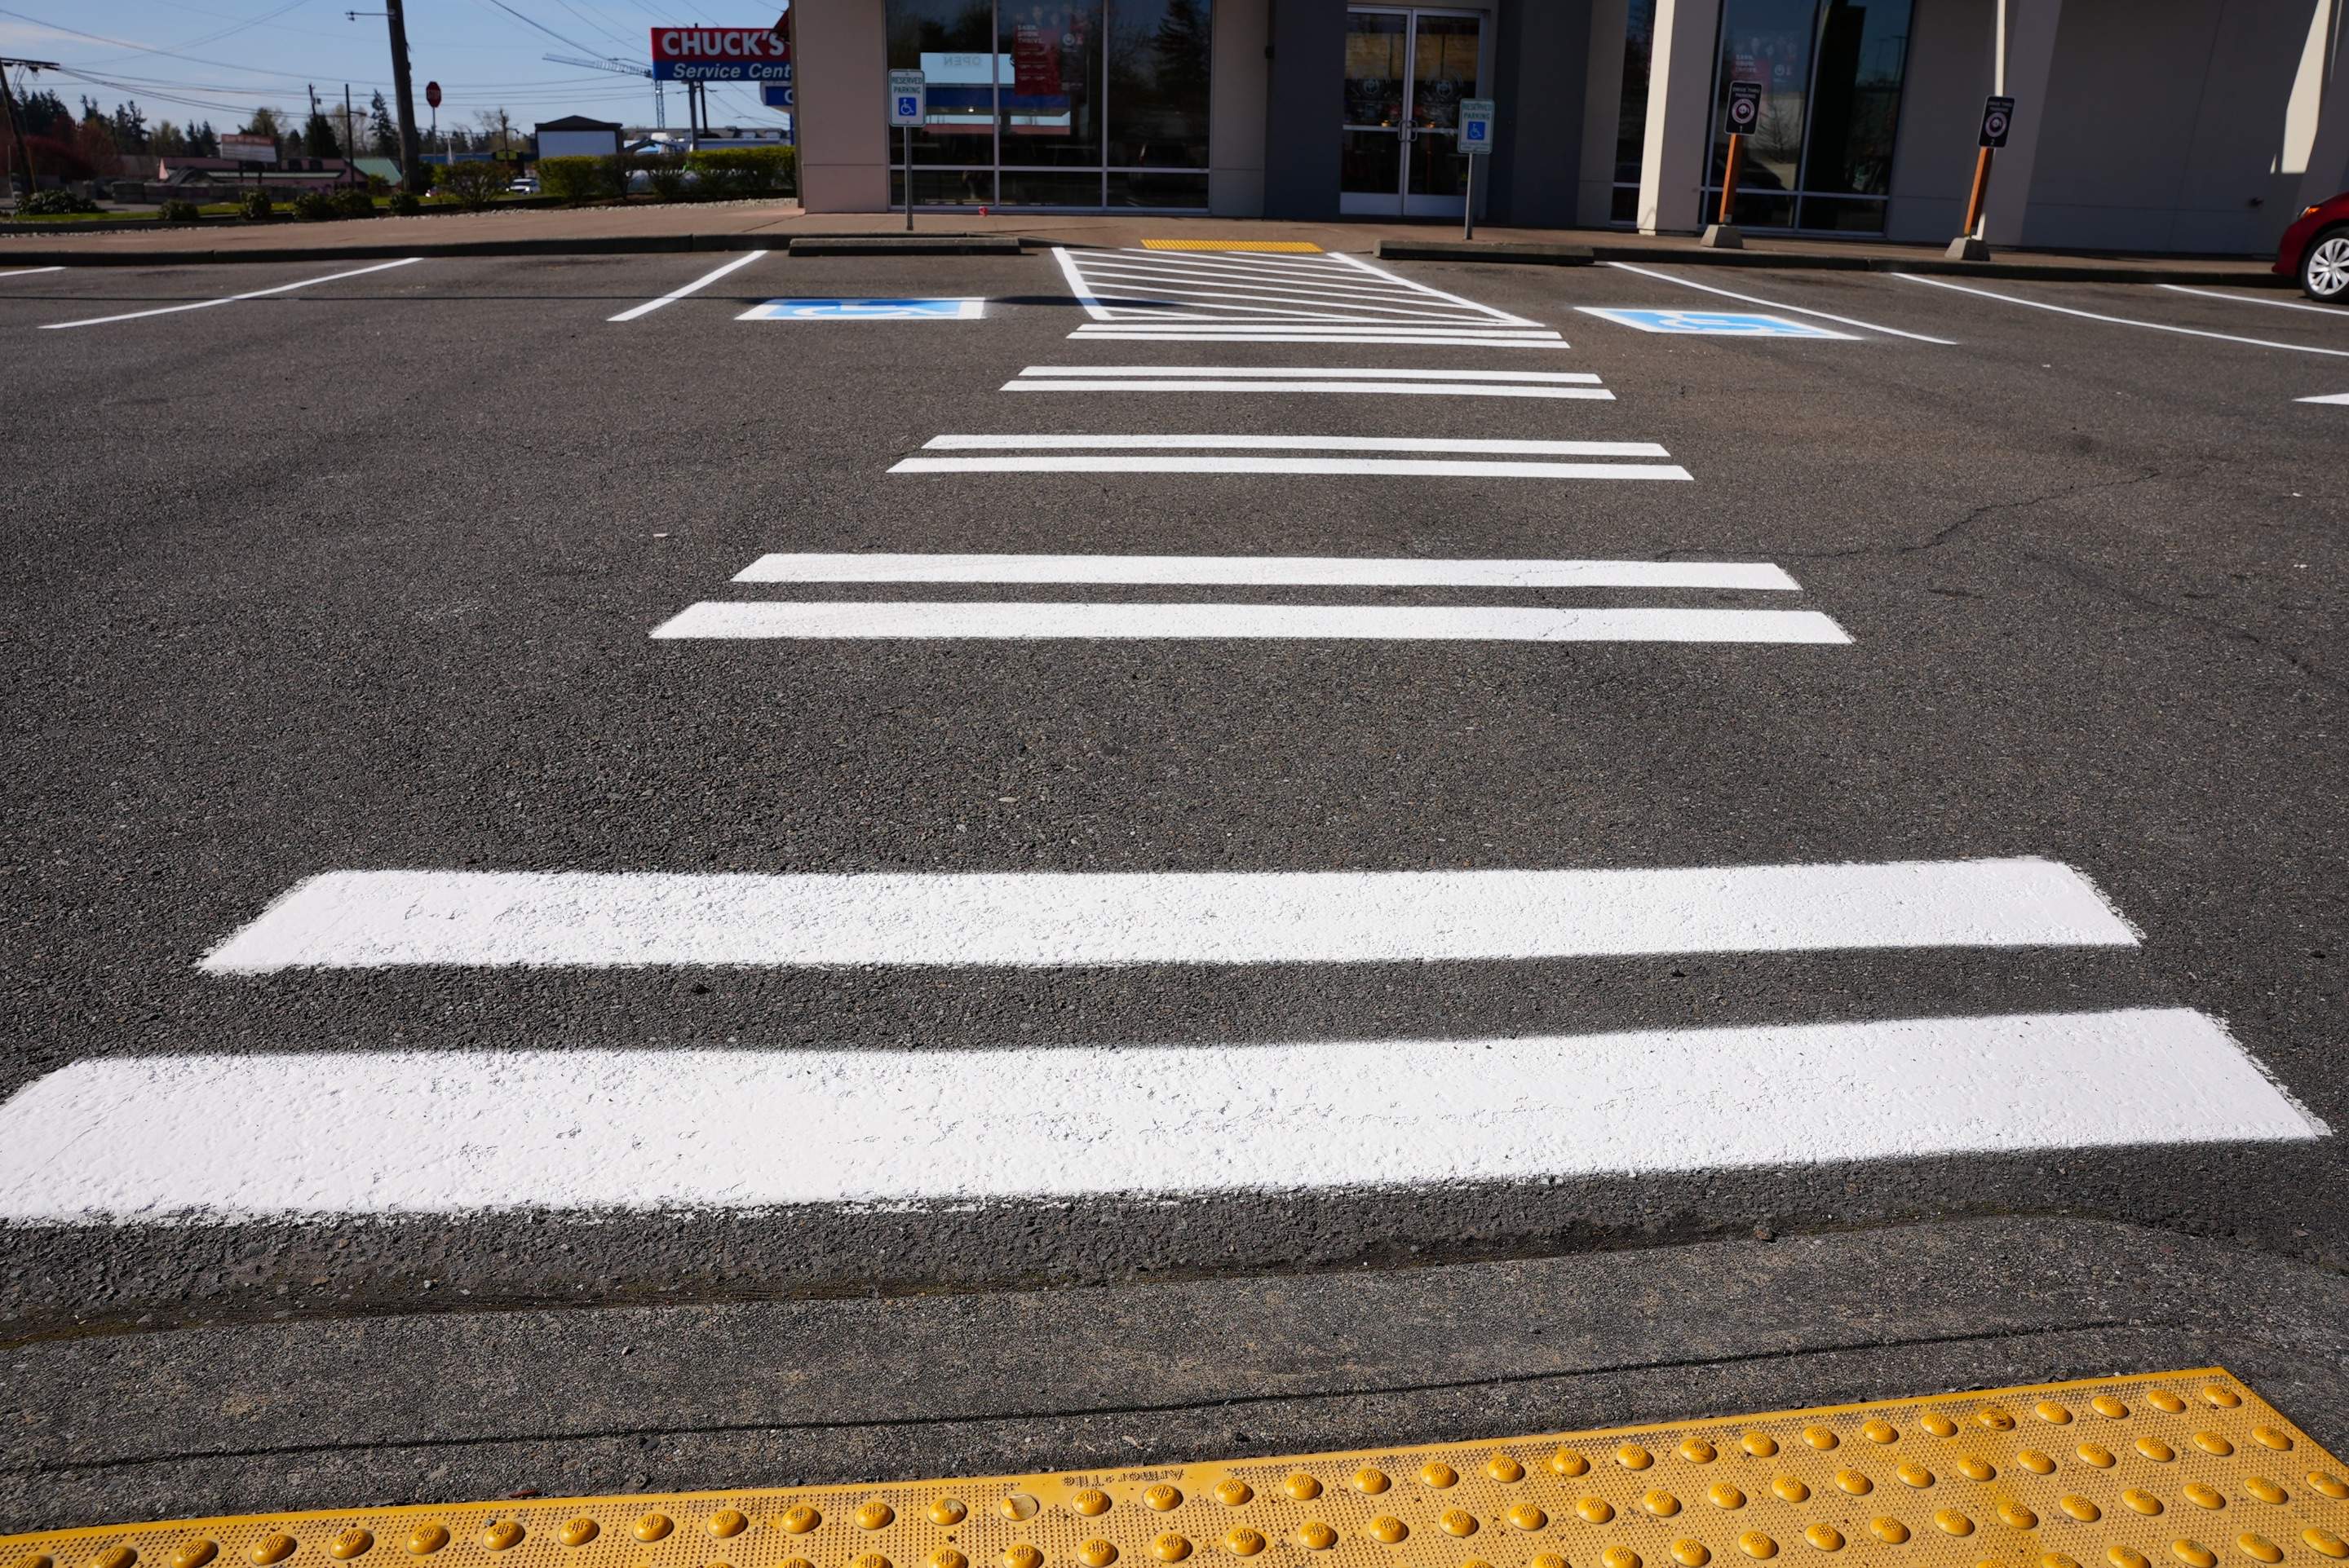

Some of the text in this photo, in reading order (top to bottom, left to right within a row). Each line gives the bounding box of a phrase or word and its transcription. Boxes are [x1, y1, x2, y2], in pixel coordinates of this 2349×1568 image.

[661, 31, 785, 56] CHUCK'S
[673, 63, 792, 78] Service Cent
[891, 77, 923, 85] RESERVED
[893, 86, 921, 94] PARKING
[1463, 112, 1490, 121] PARKING
